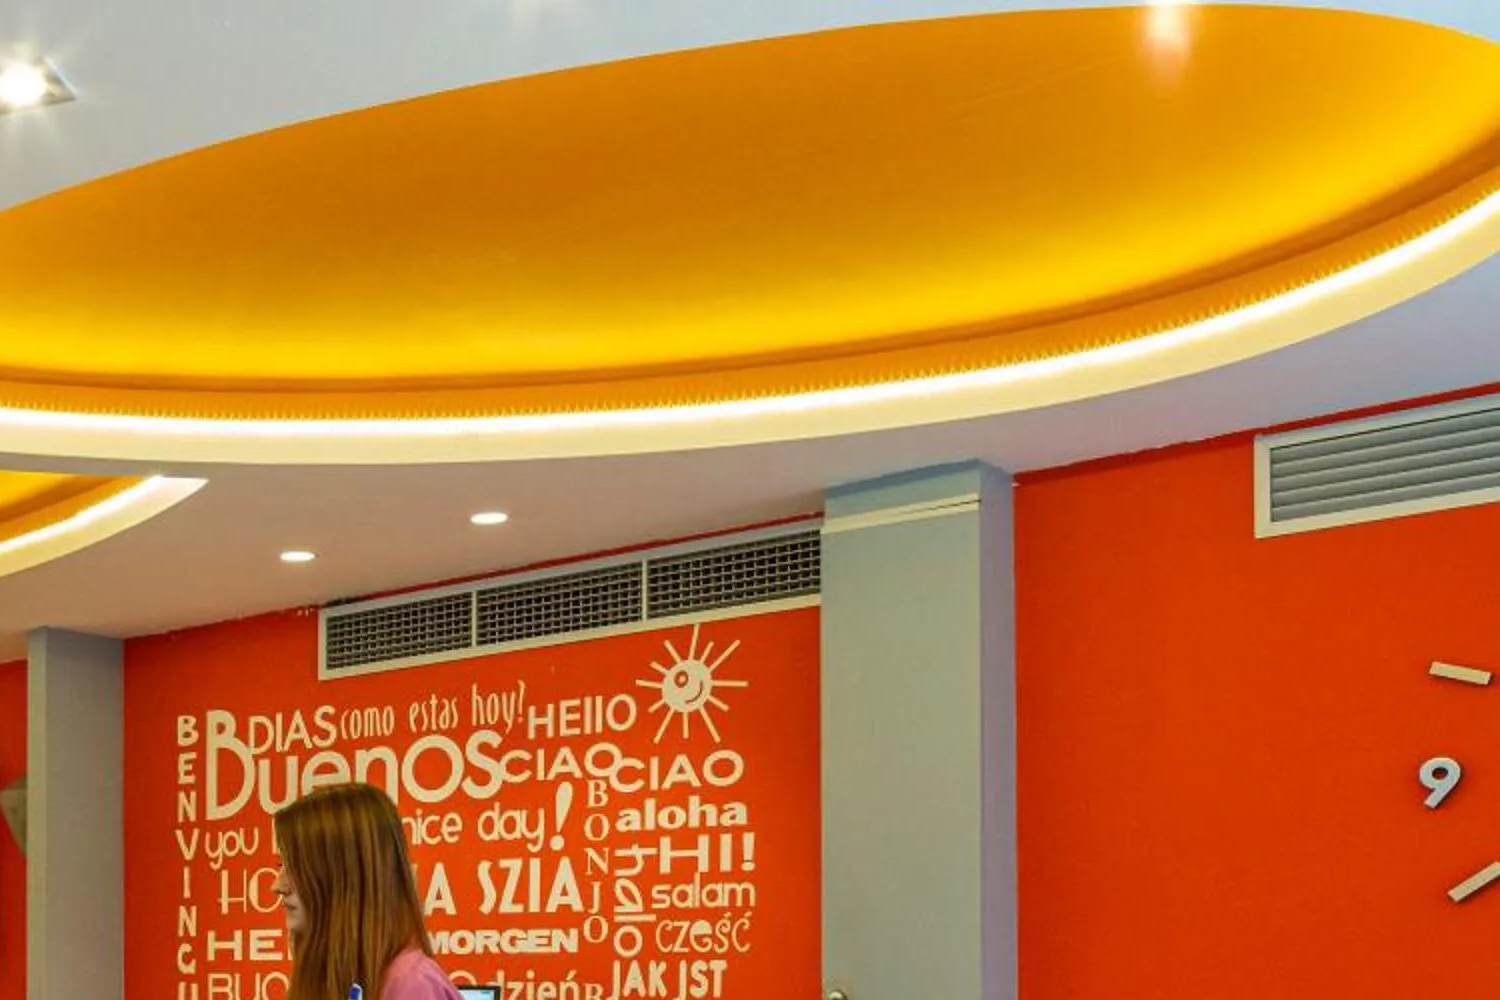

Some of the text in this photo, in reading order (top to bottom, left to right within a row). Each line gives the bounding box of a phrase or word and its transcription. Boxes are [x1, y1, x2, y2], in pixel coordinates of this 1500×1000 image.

[248, 704, 338, 756] DIAS
[340, 680, 525, 741] como estas hoy!
[500, 742, 745, 793] CIAO CIAO
[1418, 757, 1462, 809] 9
[615, 795, 749, 833] aloha
[204, 826, 260, 872] you
[659, 832, 756, 875] HI!
[477, 856, 585, 915] SZIA
[651, 872, 756, 909] salam
[428, 928, 579, 955] MORGEN
